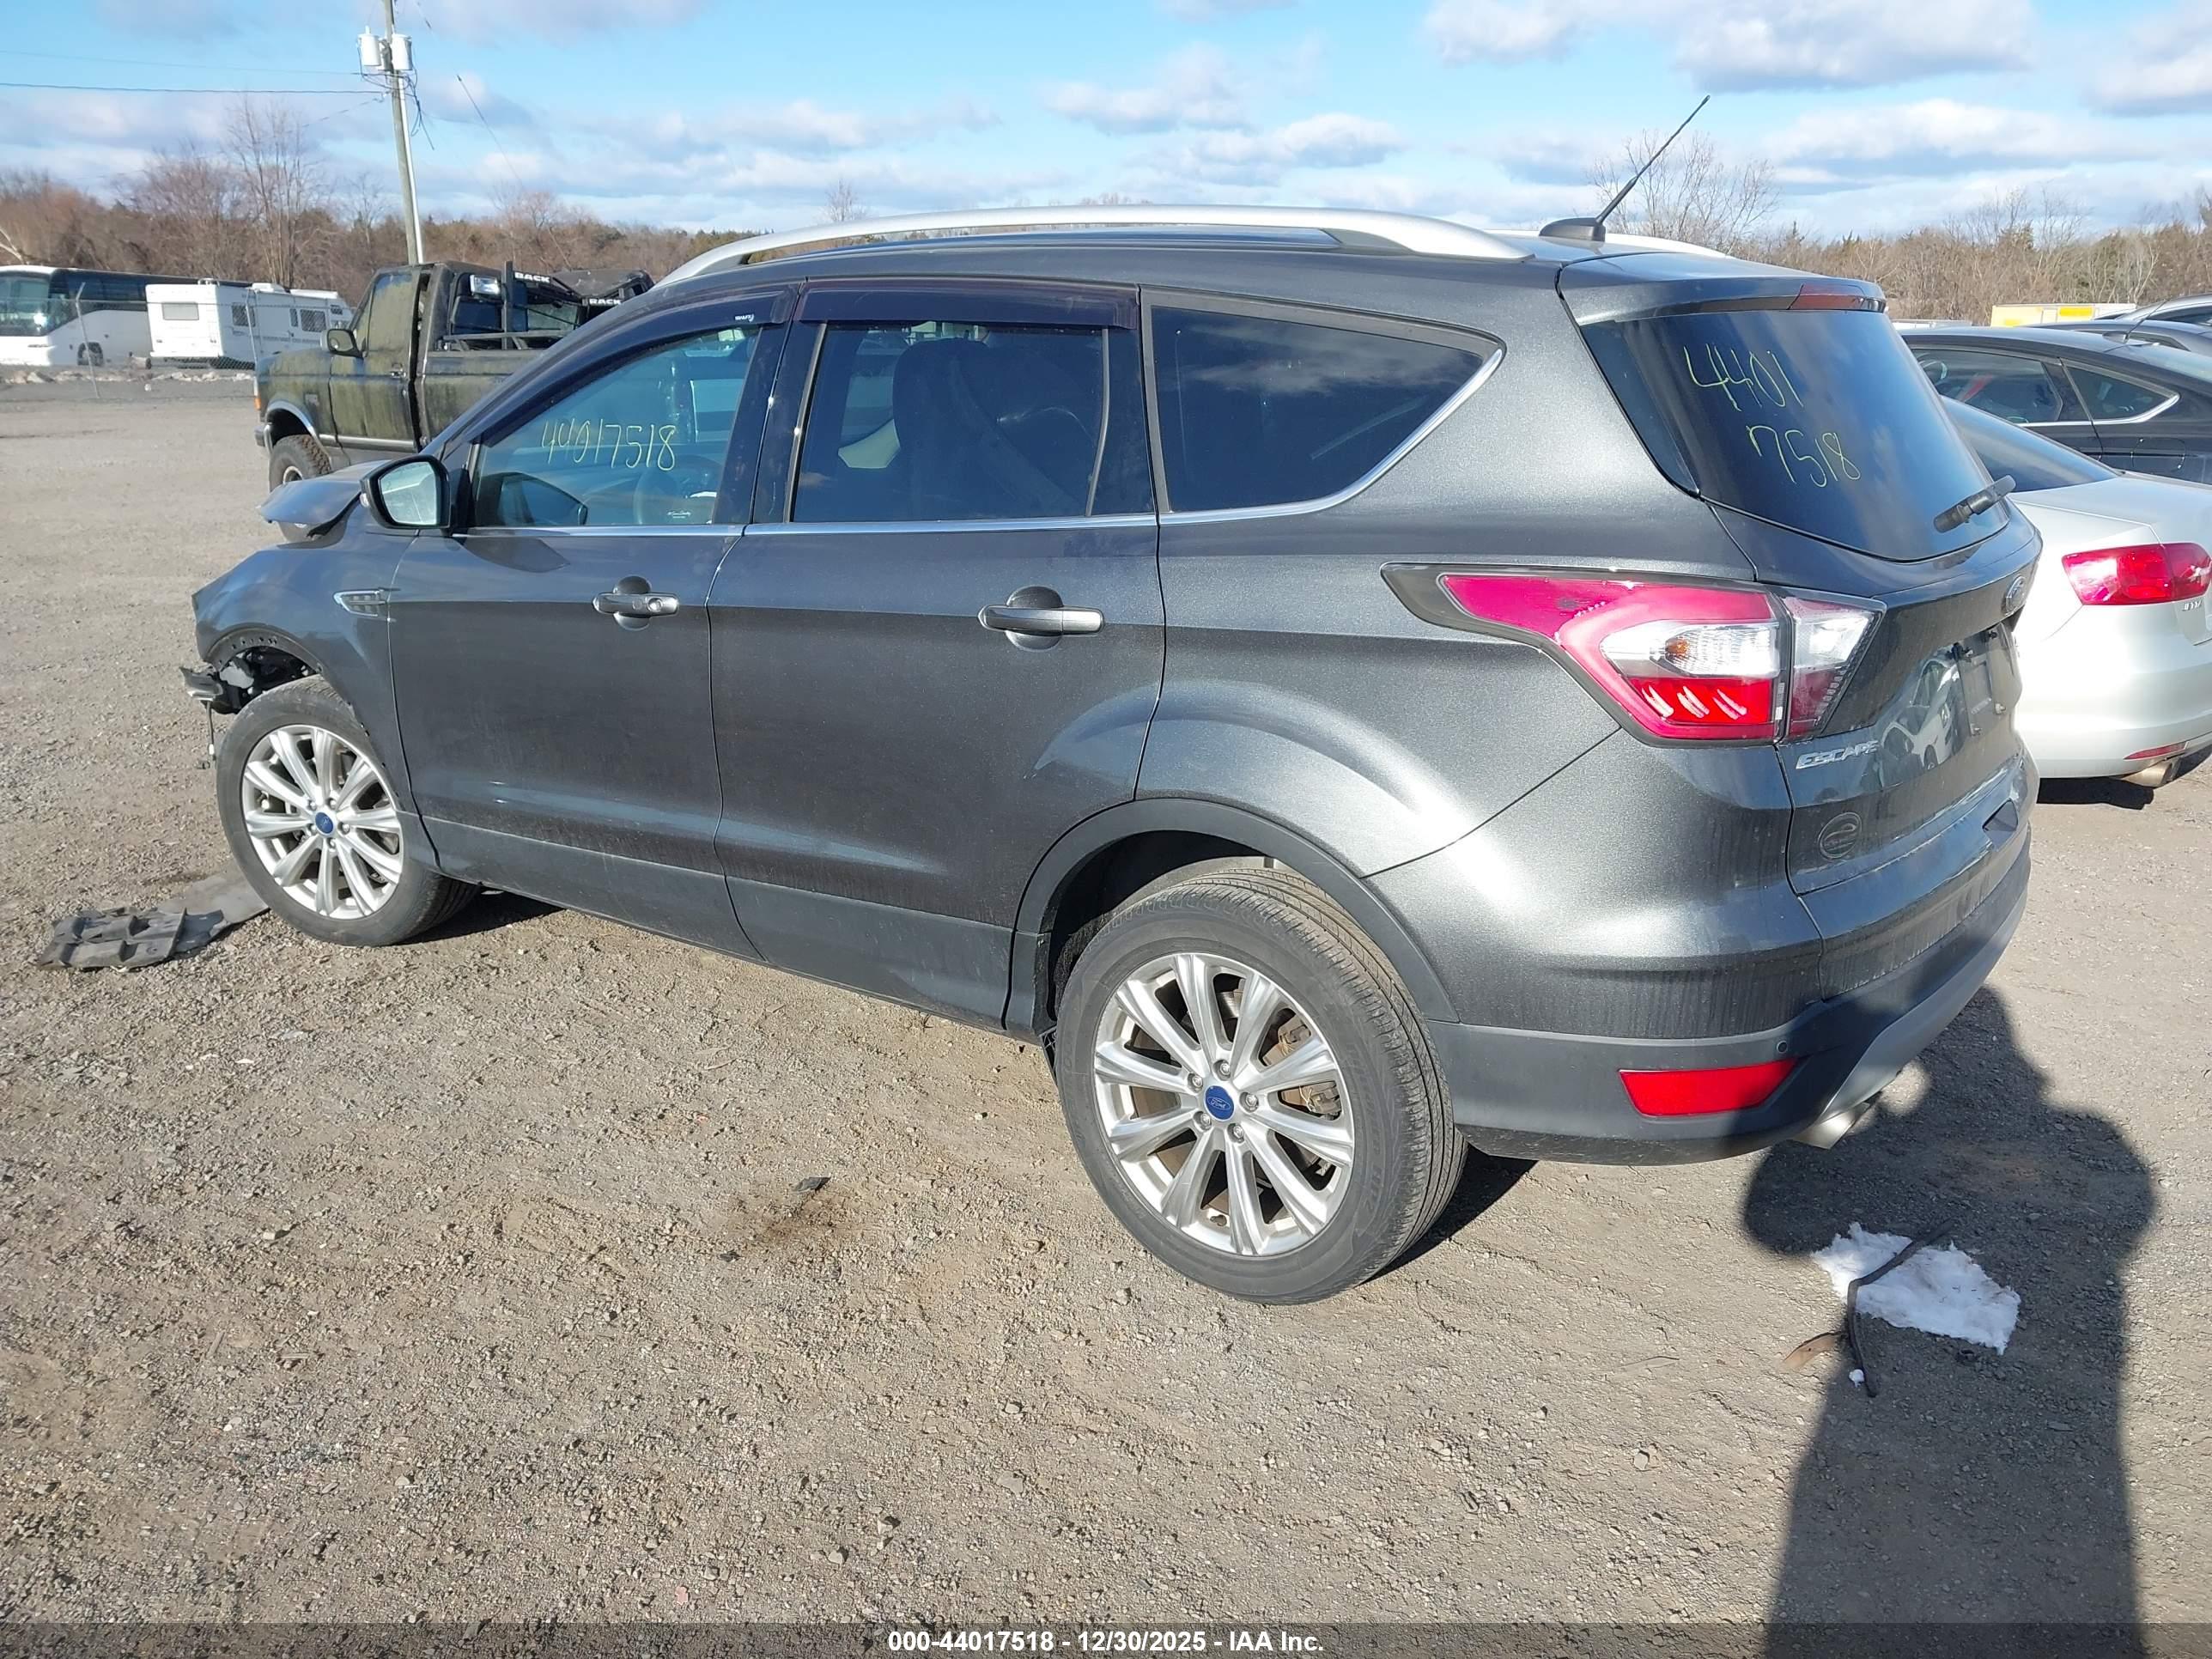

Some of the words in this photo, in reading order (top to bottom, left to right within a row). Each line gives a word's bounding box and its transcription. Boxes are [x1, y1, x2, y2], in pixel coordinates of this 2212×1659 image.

[1683, 343, 1804, 412] 4401
[541, 418, 677, 471] 44017518
[1745, 425, 1862, 488] 7518
